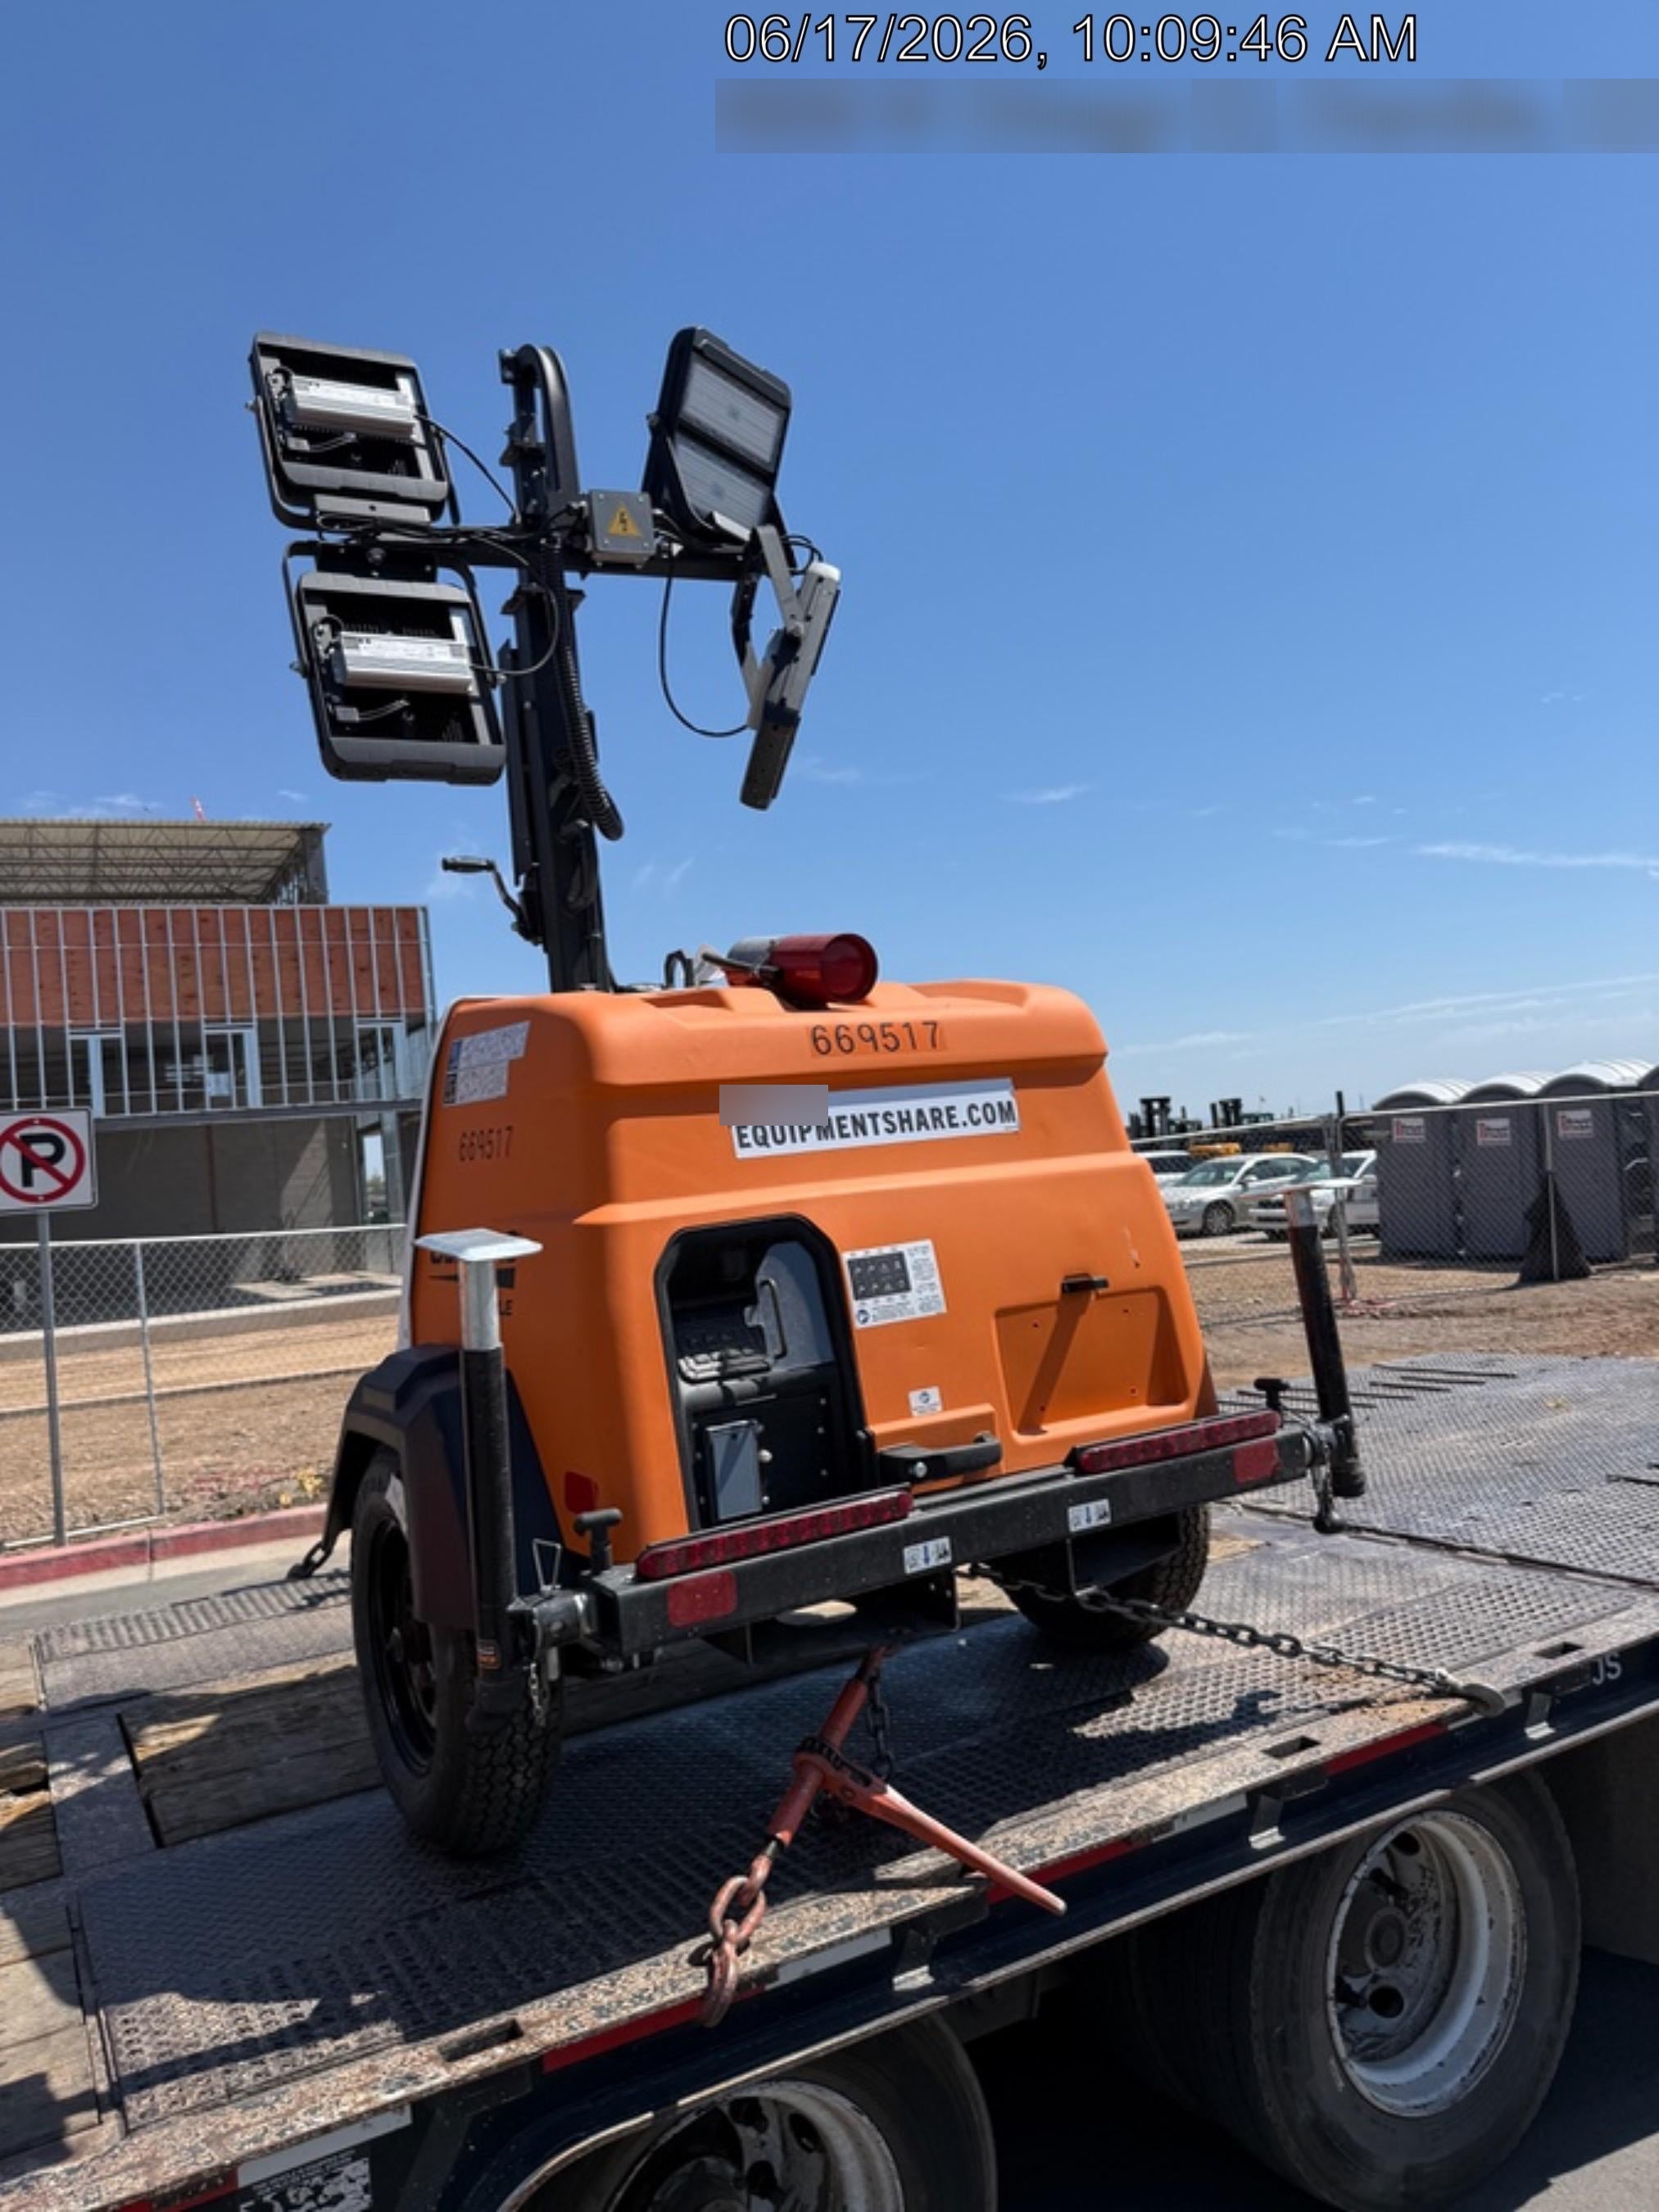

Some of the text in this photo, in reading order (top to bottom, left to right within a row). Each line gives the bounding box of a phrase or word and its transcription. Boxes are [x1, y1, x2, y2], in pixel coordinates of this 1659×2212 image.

[811, 1020, 939, 1055] 669517
[459, 1124, 513, 1163] 669517
[735, 1099, 1017, 1149] EQUIPMENTSHARE.COM
